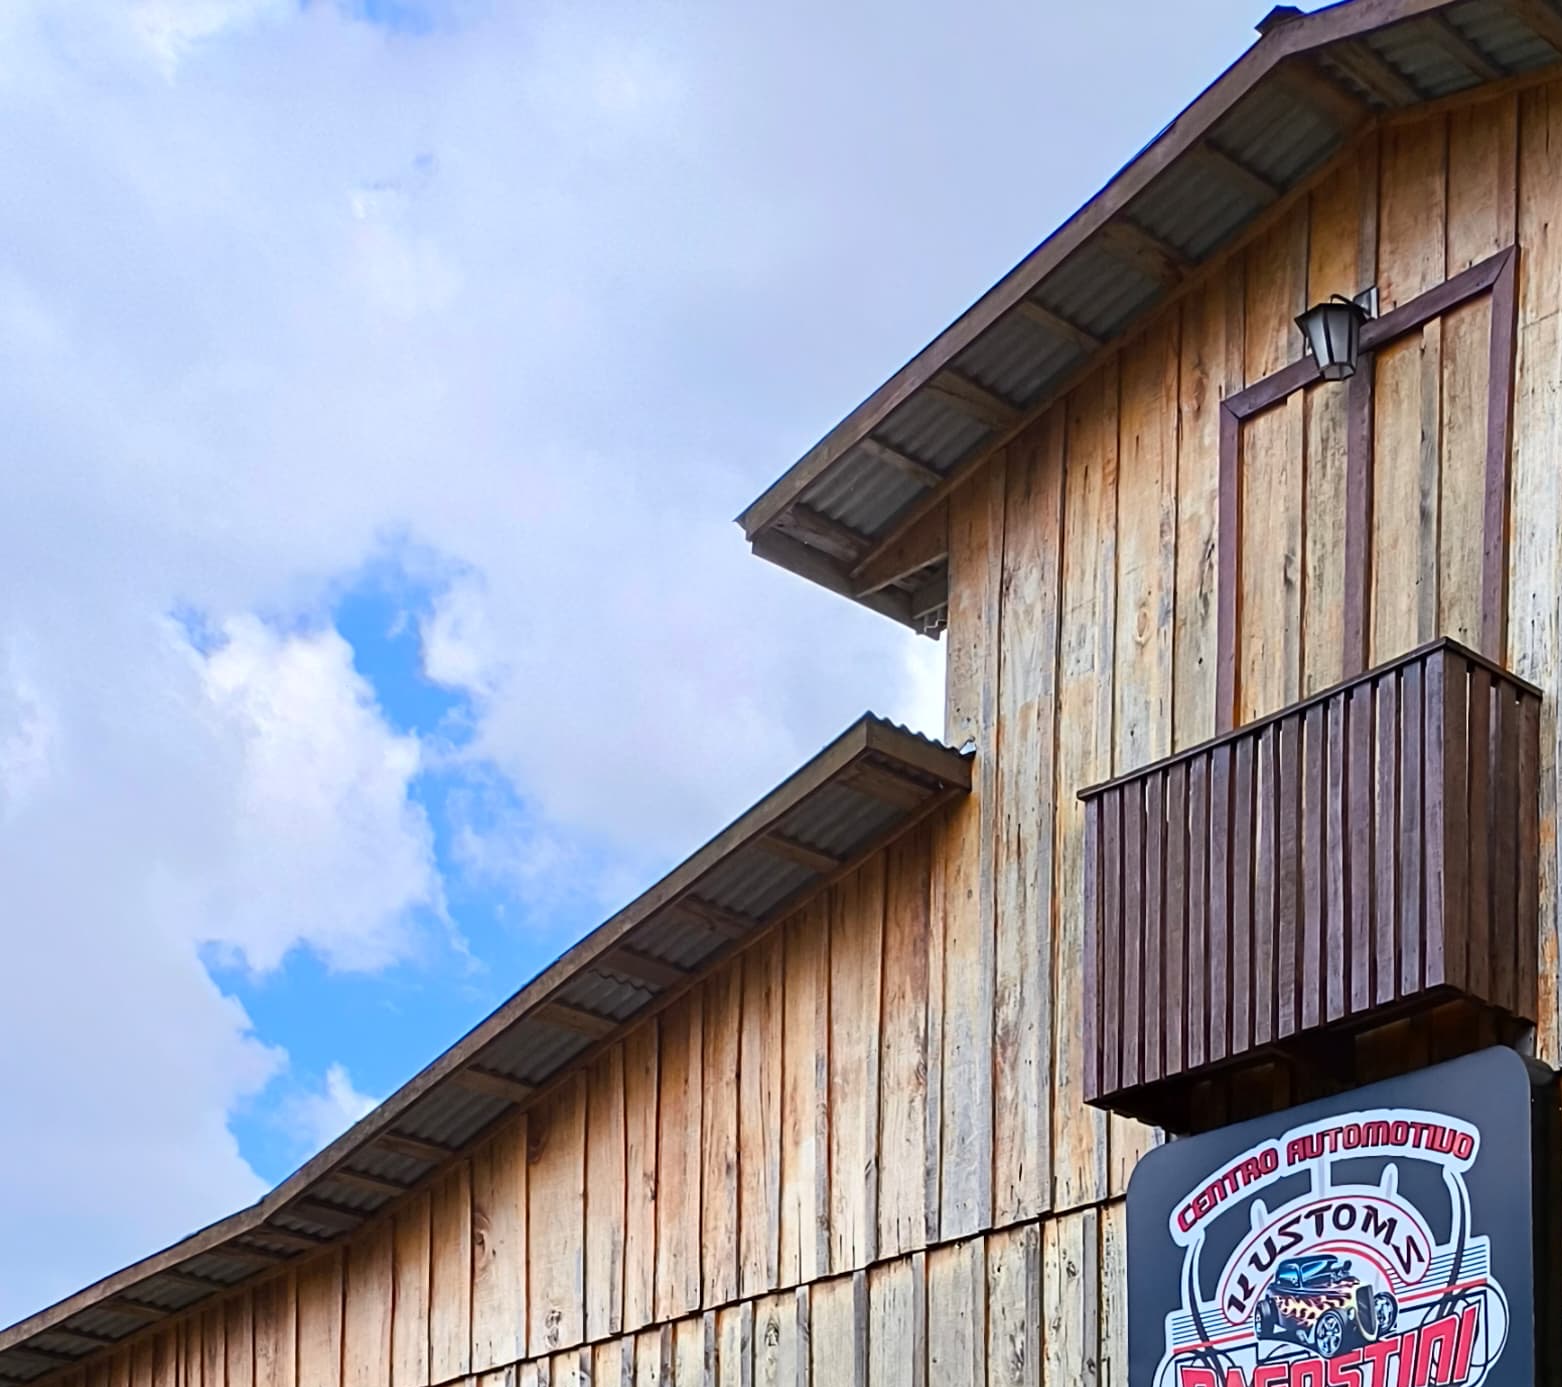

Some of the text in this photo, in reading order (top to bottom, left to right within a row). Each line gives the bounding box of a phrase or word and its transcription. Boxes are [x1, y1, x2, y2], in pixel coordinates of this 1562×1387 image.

[1176, 1120, 1475, 1233] CENTRO AUTOMOTIVO
[1227, 1202, 1427, 1318] KUSTOMS
